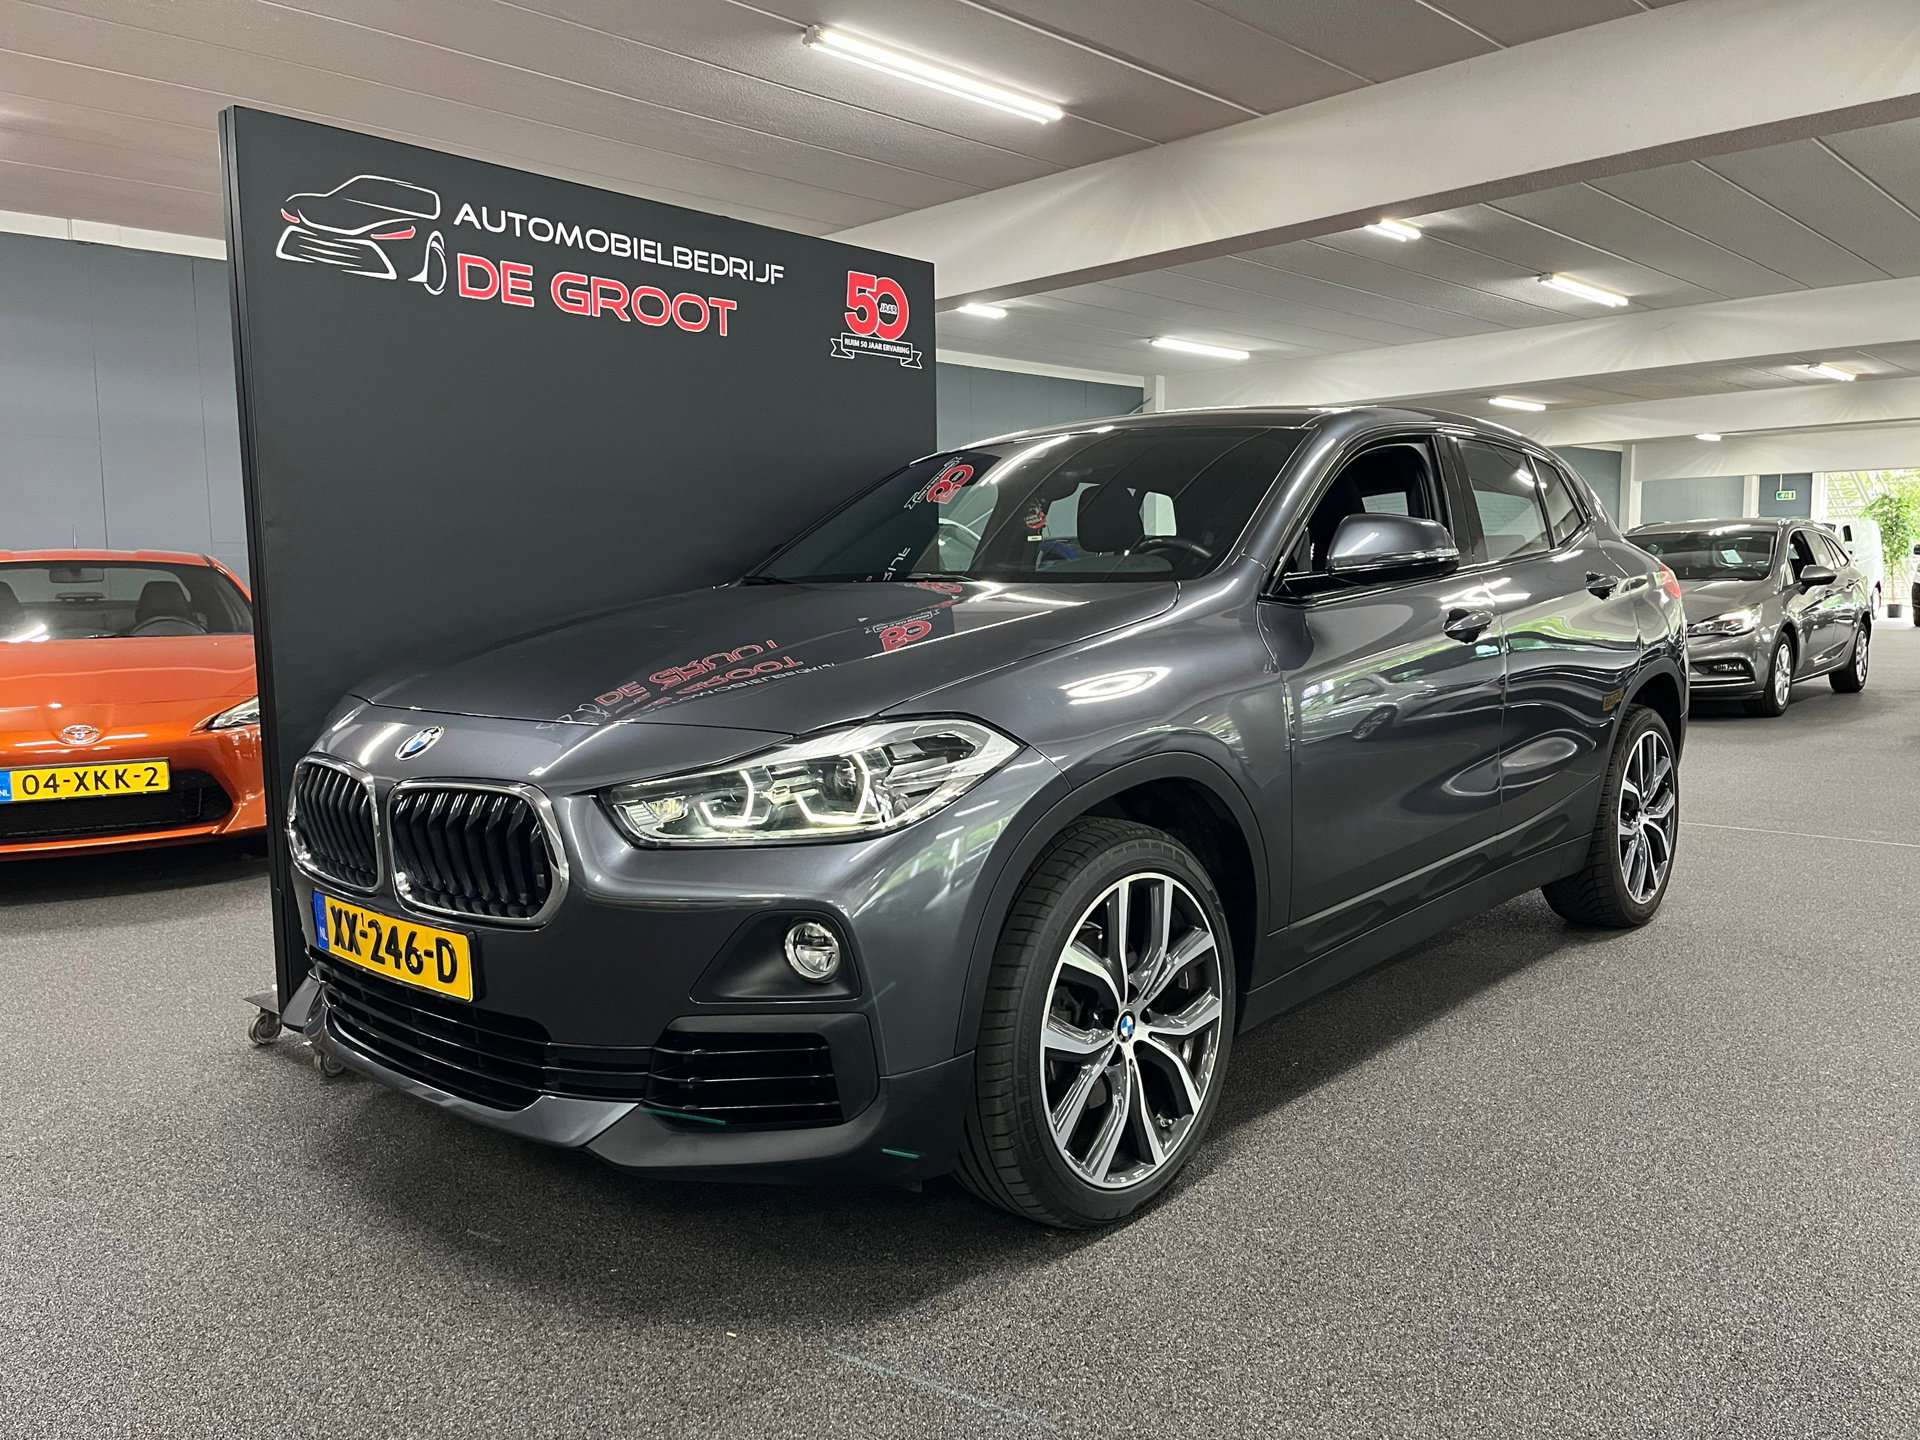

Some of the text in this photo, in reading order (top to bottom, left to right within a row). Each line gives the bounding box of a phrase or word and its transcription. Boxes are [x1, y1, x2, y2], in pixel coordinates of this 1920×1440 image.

[453, 202, 785, 285] AUTOMOBIELBEDRIJF
[456, 252, 738, 337] DE GROOT
[844, 270, 910, 341] 50
[879, 302, 898, 315] JAAR
[844, 338, 910, 355] RUIM 50 JAAR ERVARING
[22, 766, 160, 796] 04-XKK-2
[319, 905, 458, 984] NL XX-246-D
